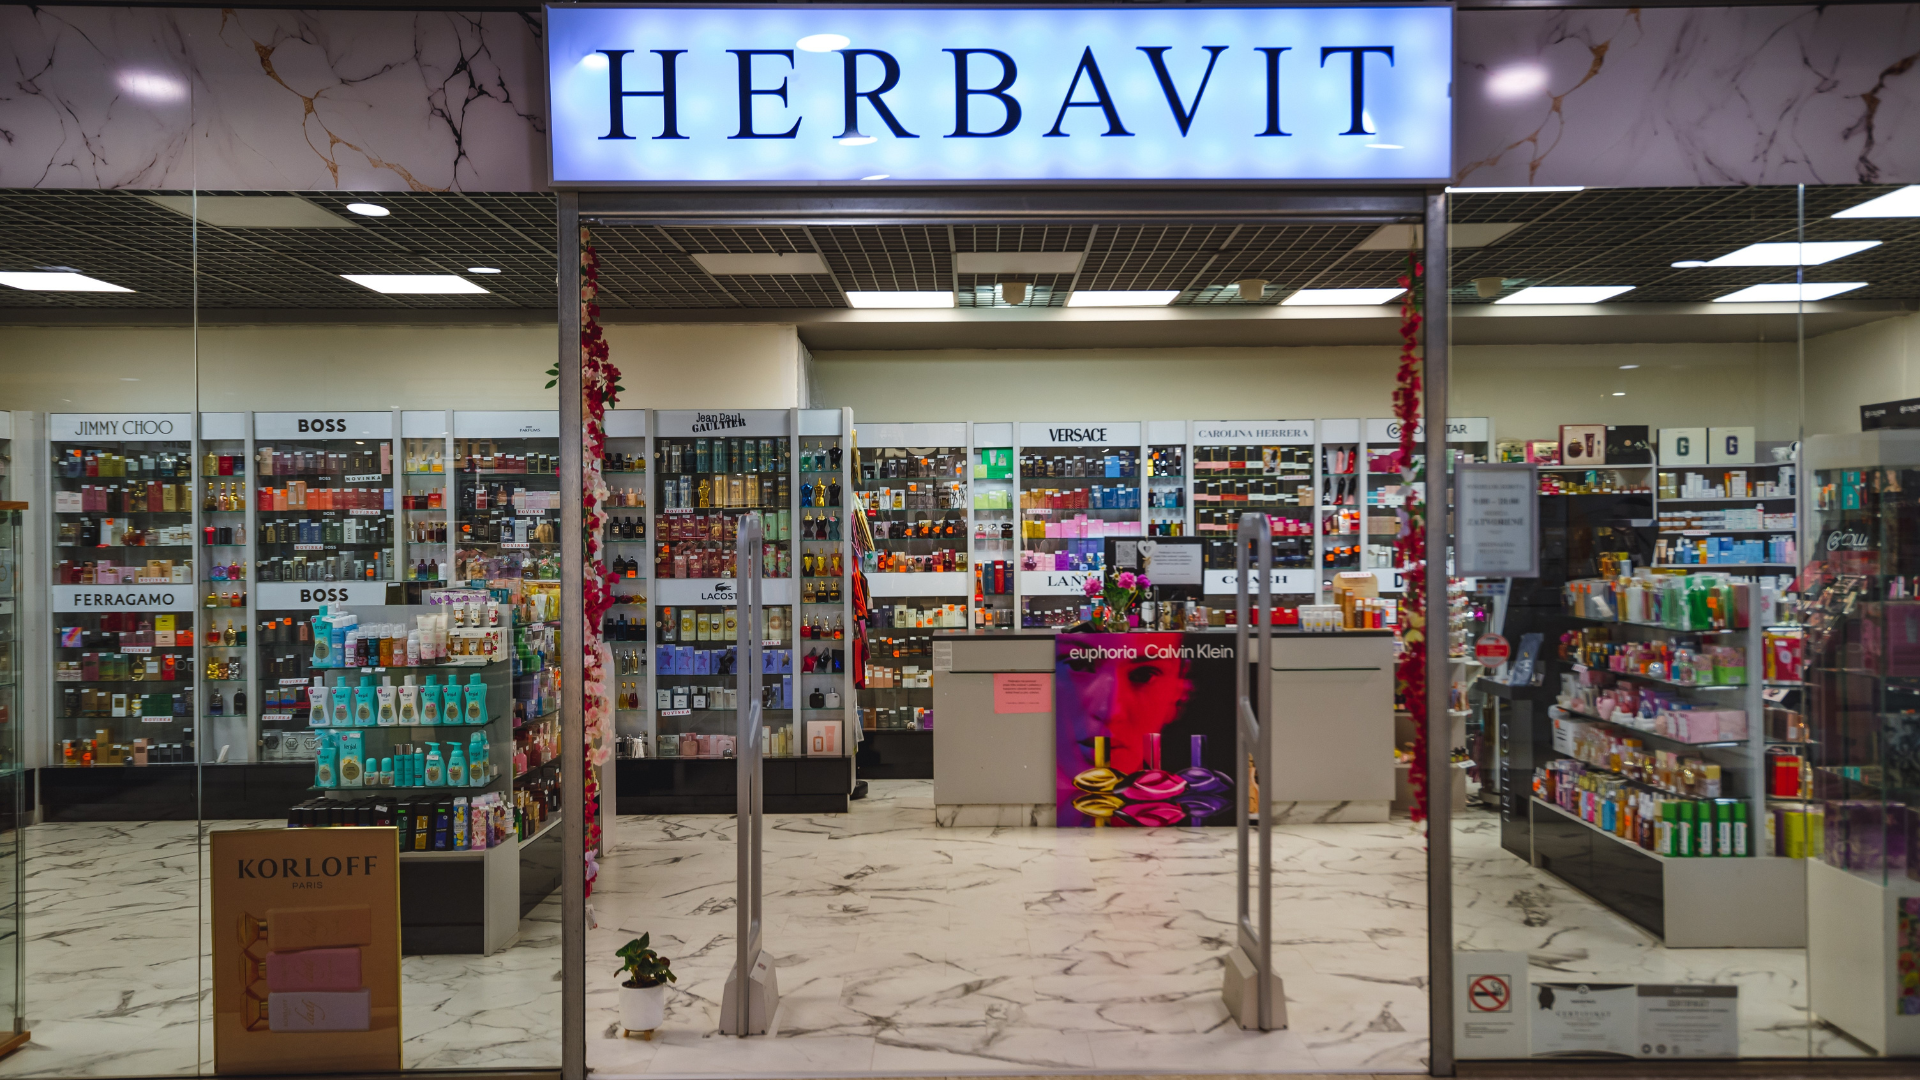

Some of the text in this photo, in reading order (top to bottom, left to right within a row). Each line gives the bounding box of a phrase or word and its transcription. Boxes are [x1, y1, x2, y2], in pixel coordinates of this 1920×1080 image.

[595, 45, 1395, 140] HERBAVIT
[696, 412, 741, 423] Jean Paul
[75, 420, 173, 435] JIMMY CHOO
[298, 419, 346, 432] BOSS
[692, 418, 746, 432] GAULTIER
[1049, 428, 1108, 442] VERSACE
[1198, 429, 1309, 438] CAROLINA HERRERA
[1676, 437, 1690, 457] G
[1725, 435, 1739, 456] G
[74, 593, 175, 606] FERRAGAMO
[300, 588, 349, 603] BOSS
[701, 592, 738, 600] LACOST
[1069, 643, 1234, 663] euphoria Calvin Klein
[238, 856, 378, 879] KORLOFF
[292, 881, 323, 889] PARIS
